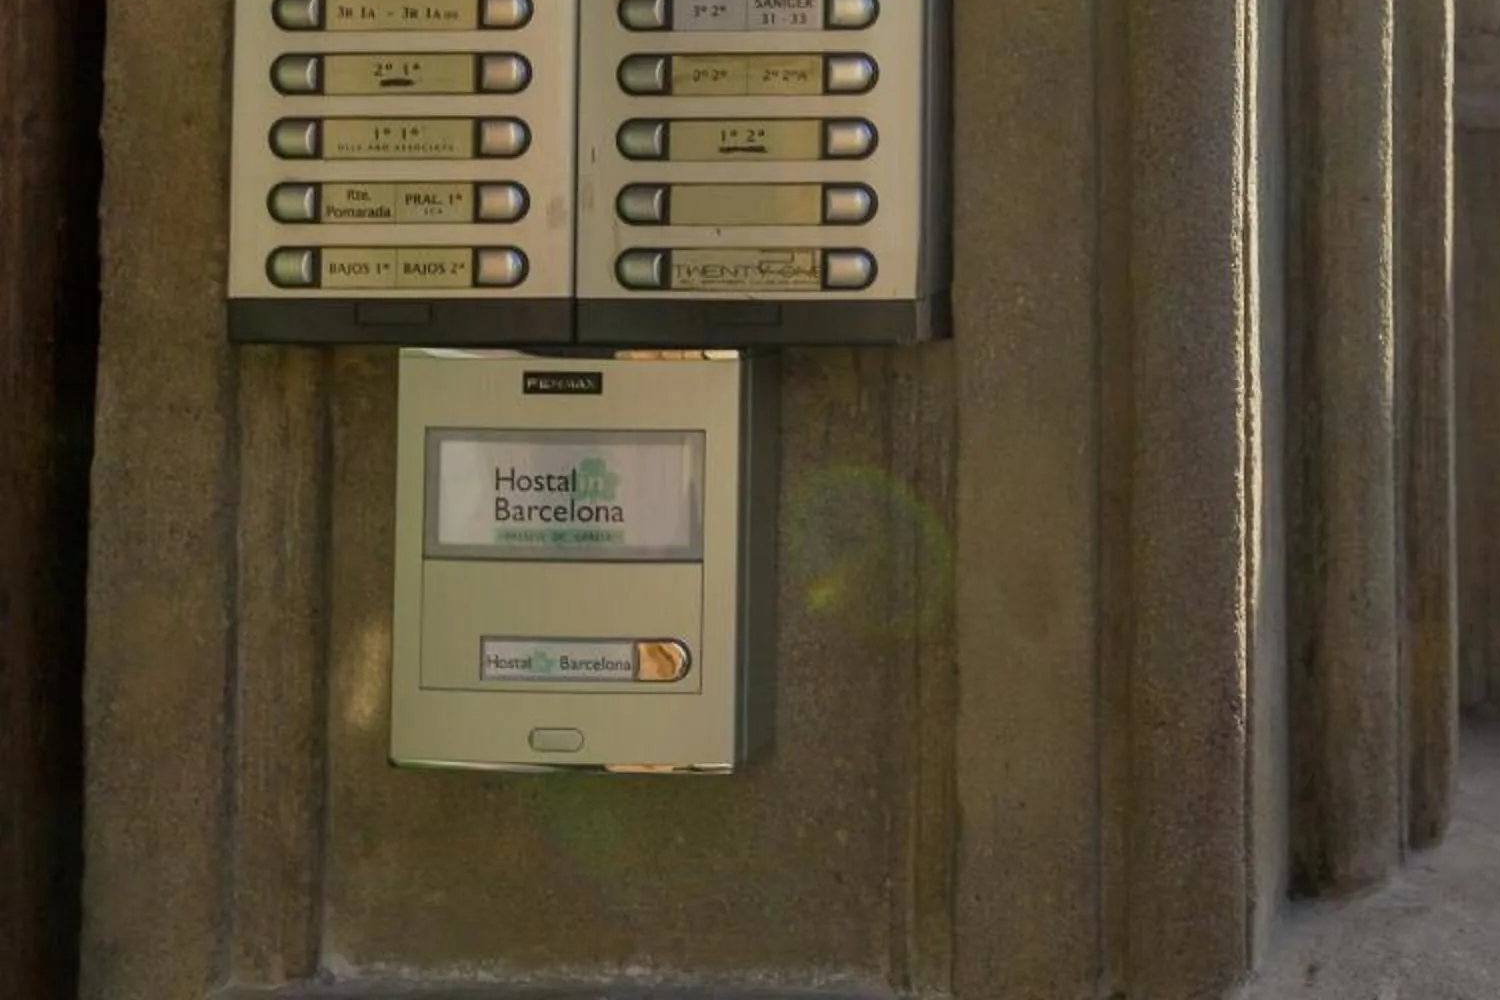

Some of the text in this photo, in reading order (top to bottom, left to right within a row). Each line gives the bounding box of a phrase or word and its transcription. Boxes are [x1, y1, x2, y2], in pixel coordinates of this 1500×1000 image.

[325, 204, 391, 219] Pomarada
[328, 262, 370, 276] BAJOS
[403, 262, 446, 275] BAJOS
[494, 466, 577, 493] Hostal
[494, 497, 624, 523] Barcelona
[486, 653, 632, 672] Hostal Barcelona
